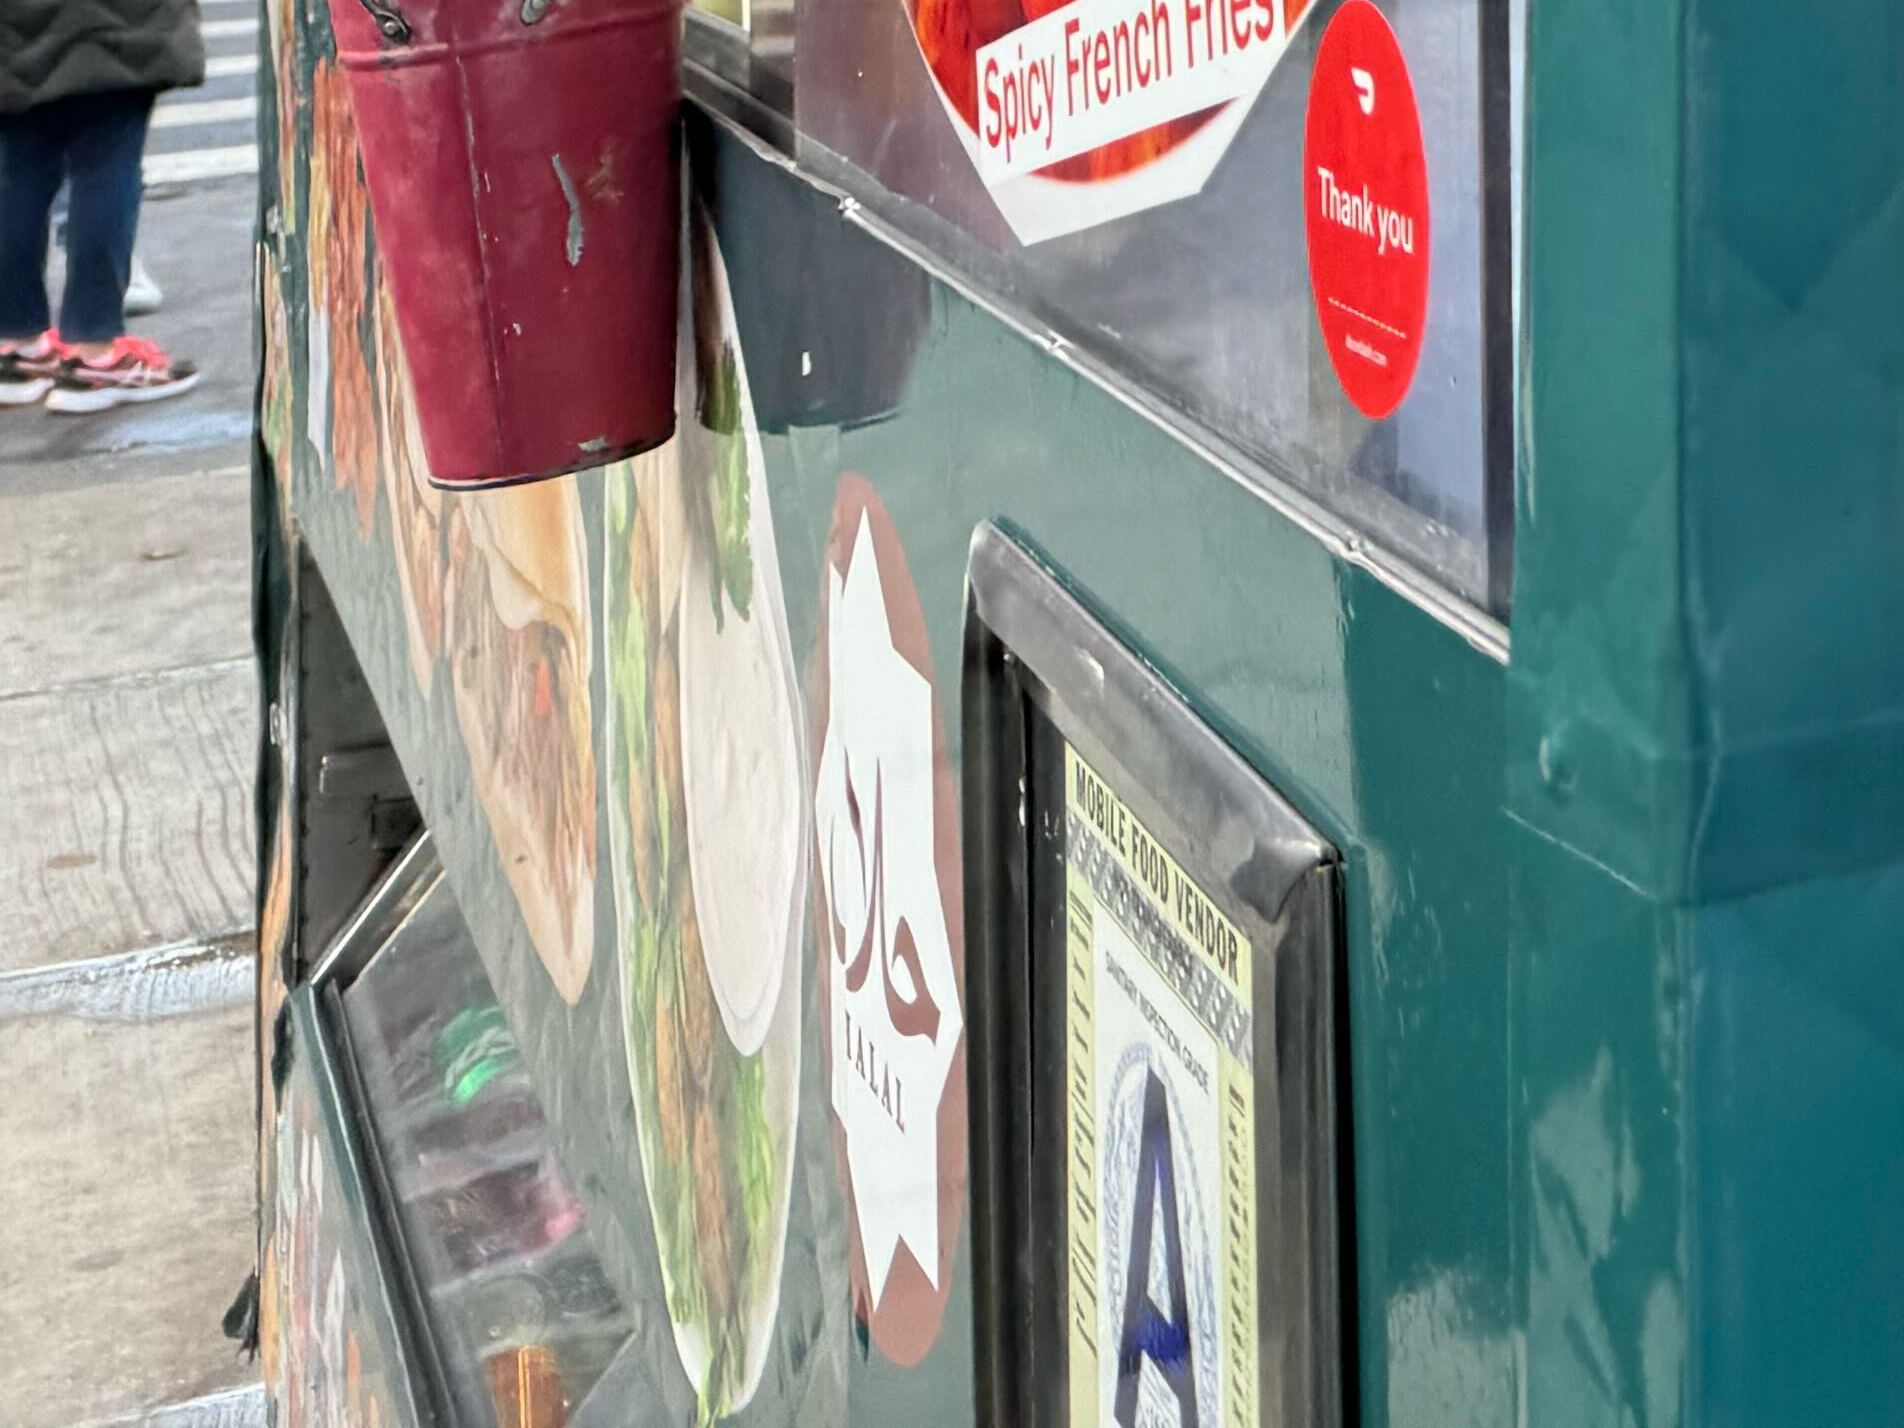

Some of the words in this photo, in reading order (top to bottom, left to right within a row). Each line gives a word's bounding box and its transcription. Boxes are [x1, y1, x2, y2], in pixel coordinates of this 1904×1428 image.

[983, 43, 1055, 163] Spicy
[1317, 165, 1375, 237] Thank
[1376, 203, 1414, 256] you
[1075, 759, 1126, 858] MOBILE
[1131, 822, 1170, 904] FOOD
[1174, 870, 1239, 986] VENDOR
[1112, 1064, 1201, 1428] A
